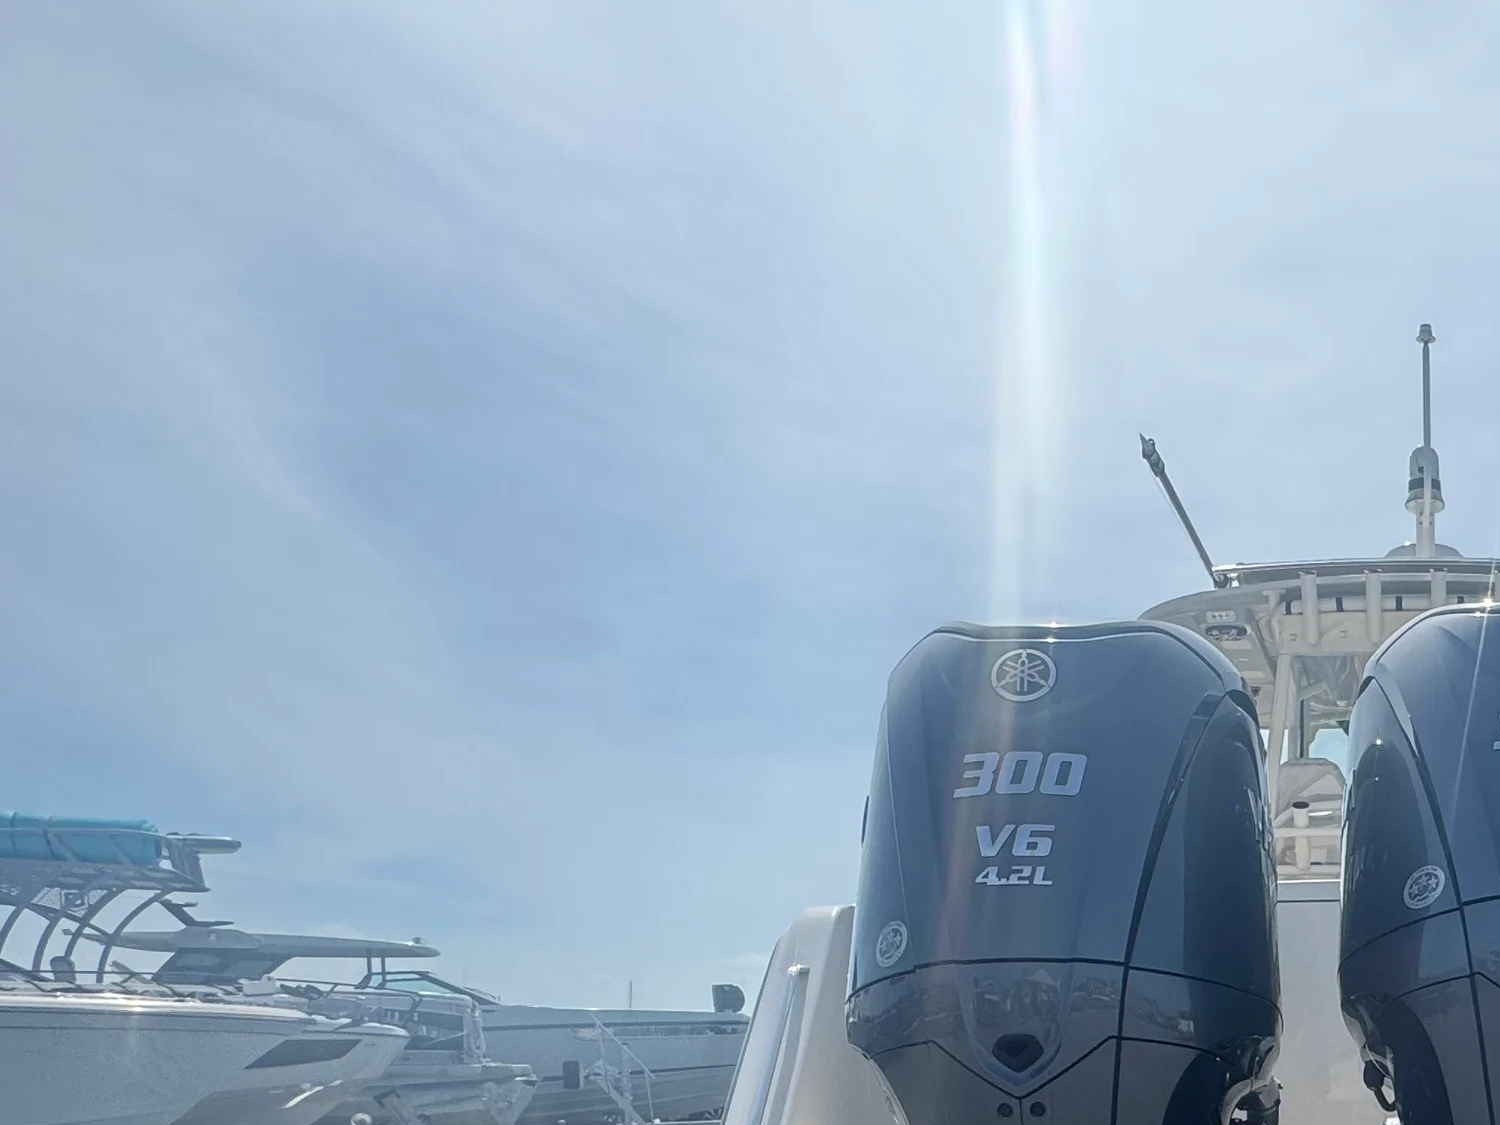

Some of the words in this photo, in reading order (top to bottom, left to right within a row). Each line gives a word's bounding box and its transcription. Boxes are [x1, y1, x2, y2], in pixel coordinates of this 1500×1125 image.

[953, 751, 1087, 798] 300
[975, 824, 1055, 857] V6
[974, 866, 1053, 885] 4.2L
